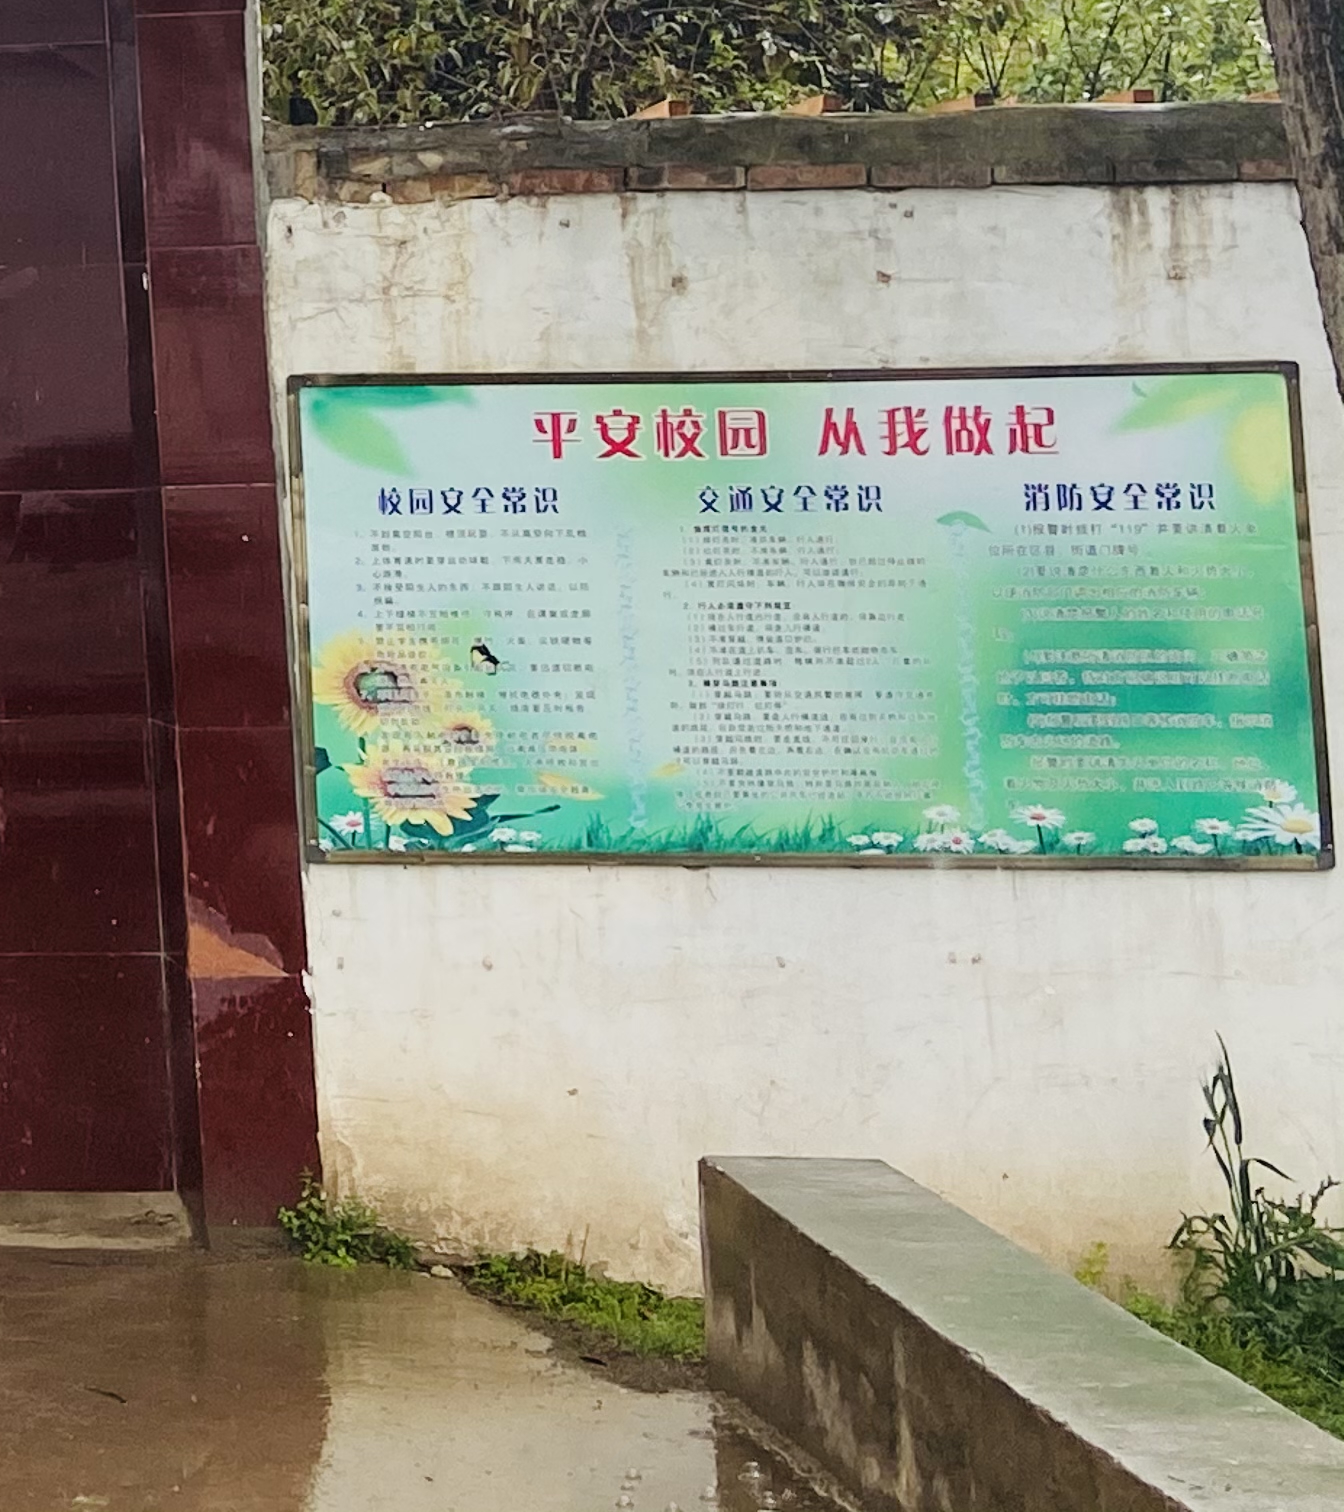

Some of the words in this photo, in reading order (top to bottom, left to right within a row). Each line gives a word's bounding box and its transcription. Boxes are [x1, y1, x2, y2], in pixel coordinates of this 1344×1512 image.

[533, 407, 770, 461] 平安校园
[817, 404, 1062, 459] 从我做起
[377, 486, 561, 516] 校园安全常识
[698, 484, 885, 514] 交通安全常识
[1023, 482, 1216, 513] 消防安全常识
